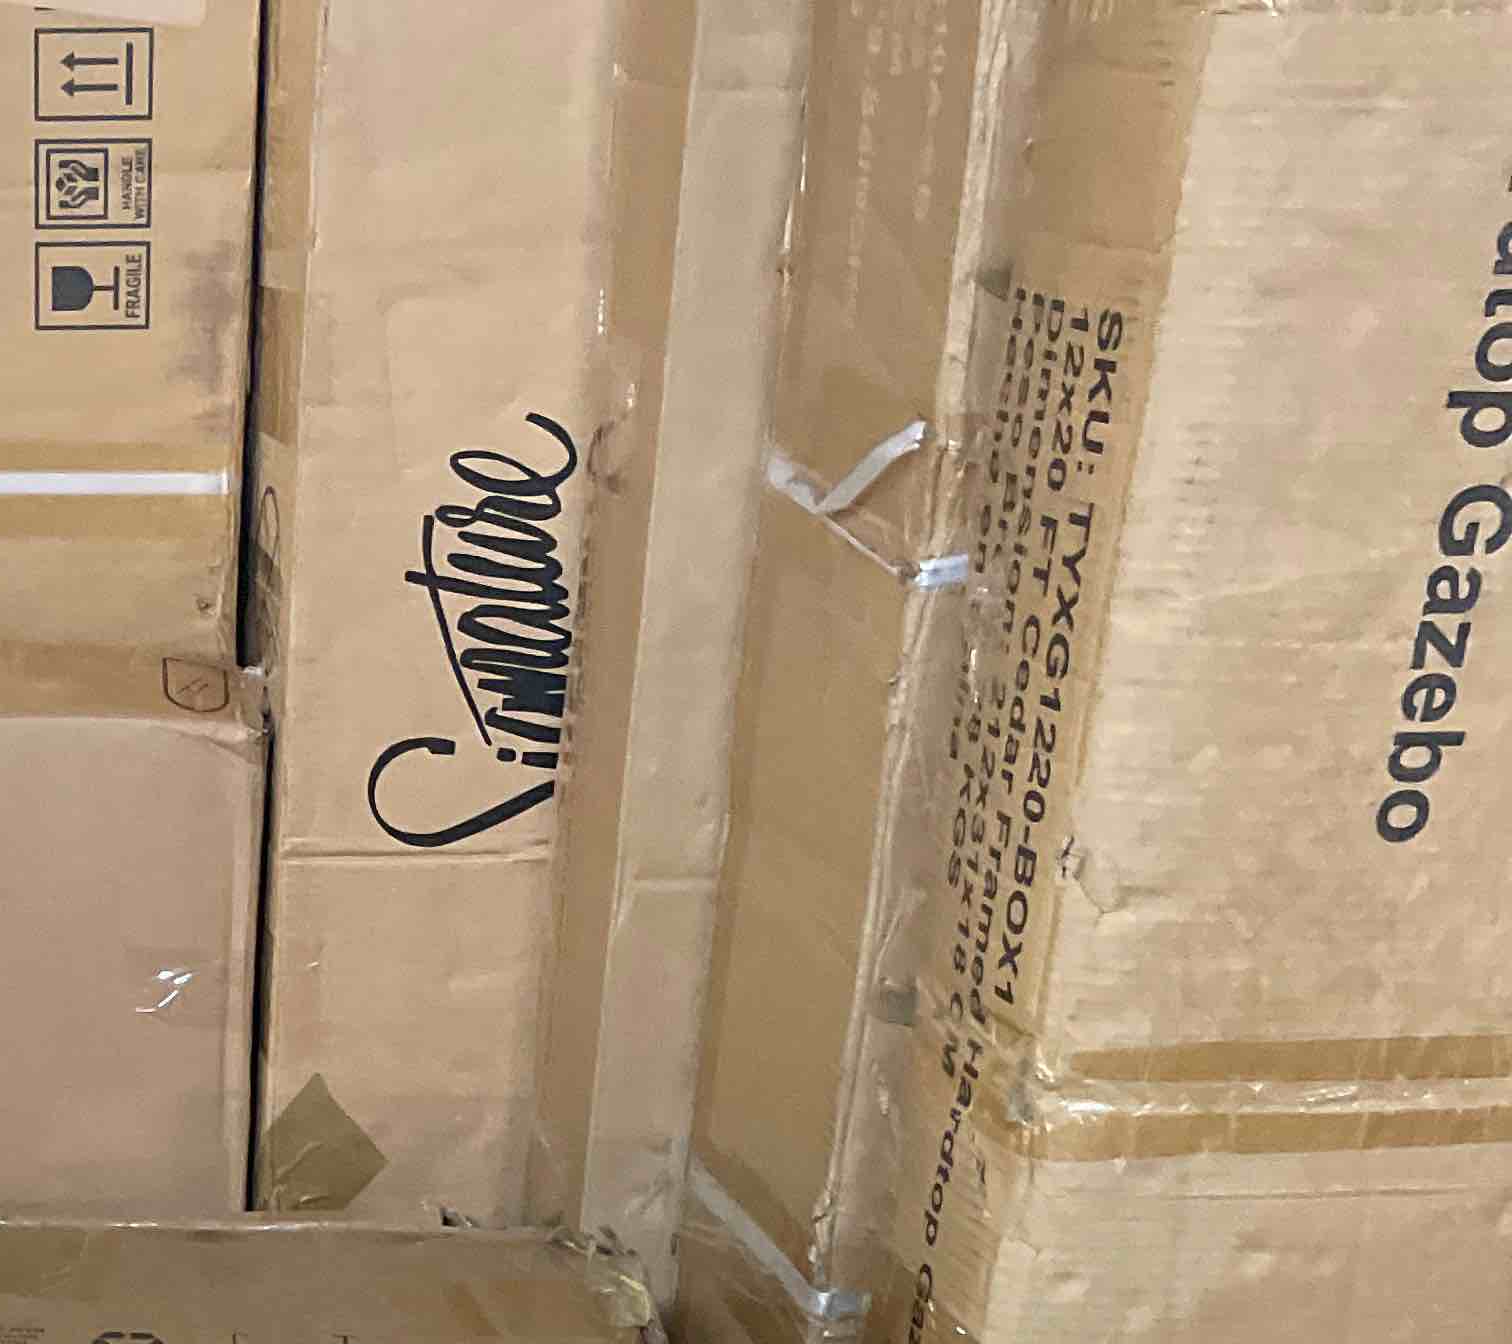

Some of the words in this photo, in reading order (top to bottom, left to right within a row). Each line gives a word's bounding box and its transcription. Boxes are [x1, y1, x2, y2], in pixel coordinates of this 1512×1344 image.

[120, 156, 134, 211] HANDLE
[125, 253, 143, 320] FRAGILE
[1047, 306, 1090, 492] 12x20
[1081, 307, 1124, 476] SKU:
[1032, 514, 1059, 598] FT
[994, 502, 1095, 1006] TYXG1220-BOX1
[1000, 614, 1041, 797] Cedar
[1375, 483, 1512, 843] Gazebo
[968, 809, 1012, 1025] Framed
